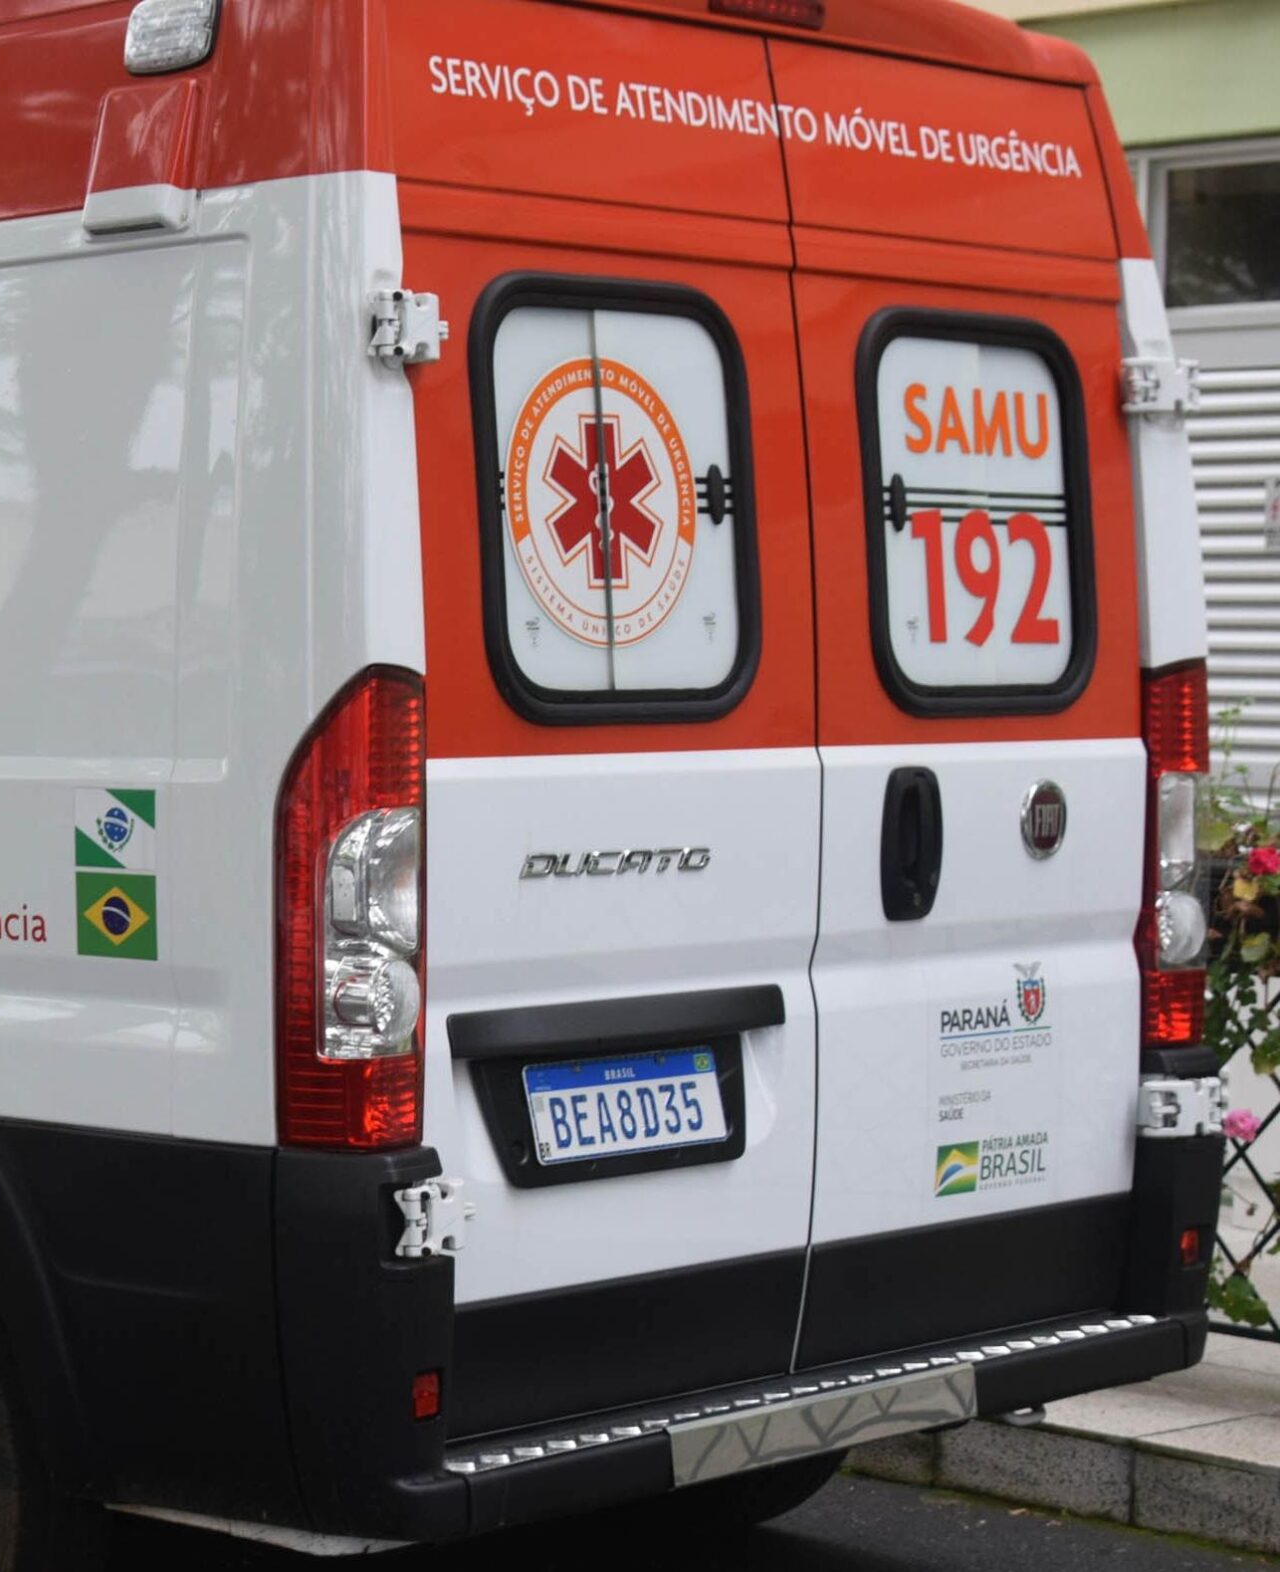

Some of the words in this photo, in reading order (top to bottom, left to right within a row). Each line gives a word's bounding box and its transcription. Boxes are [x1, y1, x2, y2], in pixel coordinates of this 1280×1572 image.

[428, 54, 560, 116] SERVIÇO
[568, 76, 607, 116] DE
[616, 81, 818, 142] ATENDIMENTO
[823, 108, 918, 158] MÓVEL
[920, 127, 955, 163] DE
[958, 129, 1083, 179] URGÊNCIA
[904, 383, 1049, 460] SAMU
[515, 445, 526, 524] SERVIÇO
[521, 420, 533, 441] DE
[619, 371, 656, 414] MÓVEL
[657, 412, 670, 435] DE
[670, 438, 691, 527] URGÊNCIA
[525, 555, 574, 624] SISTEMA
[638, 611, 655, 630] DE
[911, 509, 1059, 647] 192
[1034, 803, 1061, 838] FIAT
[520, 848, 711, 879] DUCATO
[940, 999, 1011, 1034] PARANÁ
[940, 1038, 992, 1058] GOVERNO
[994, 1037, 1010, 1053] DO
[1012, 1032, 1053, 1051] ESTADO
[604, 1067, 636, 1082] BRASIL
[548, 1080, 704, 1149] BEA8D35
[982, 1134, 1013, 1152] PÁTRIA
[1015, 1131, 1048, 1148] AMADA
[980, 1148, 1046, 1181] BRASIL
